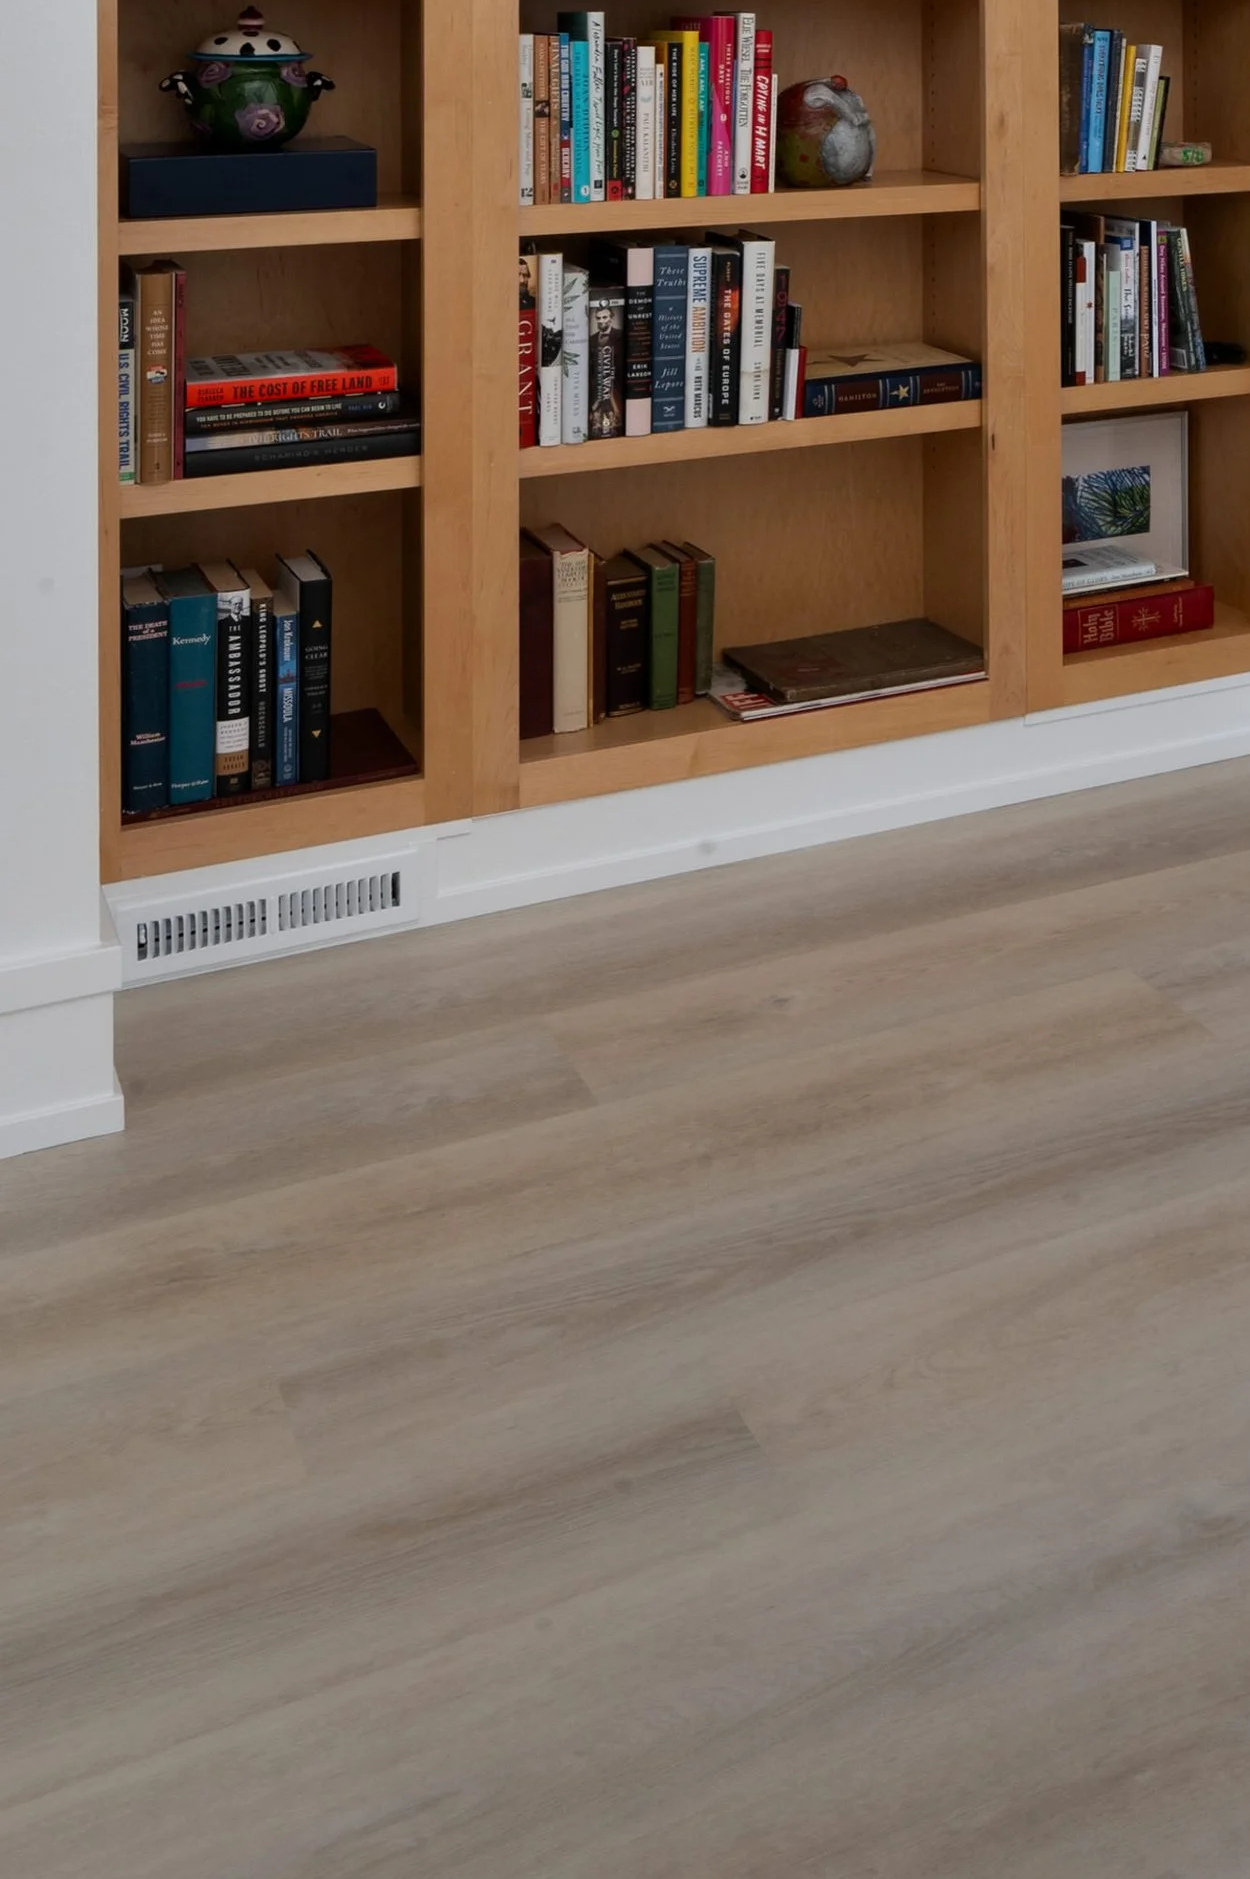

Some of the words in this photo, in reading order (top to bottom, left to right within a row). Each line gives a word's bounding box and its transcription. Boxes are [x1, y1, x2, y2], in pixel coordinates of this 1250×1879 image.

[742, 16, 754, 35] ELIE
[551, 41, 559, 76] FINAL
[740, 36, 752, 64] WIESEL
[740, 68, 752, 83] THE
[551, 78, 559, 110] GIFTS
[738, 84, 752, 128] FORGOTTEN
[757, 75, 769, 112] CRYING
[756, 125, 768, 135] H
[716, 141, 724, 177] PATCHETT
[754, 137, 767, 170] MART
[657, 279, 687, 288] Truths
[659, 267, 685, 276] These
[692, 256, 707, 303] SUPREME
[721, 289, 732, 308] THE
[119, 308, 129, 342] MOON
[692, 306, 707, 353] AMBITION
[721, 312, 732, 344] GATES
[119, 353, 129, 368] U.S.
[519, 320, 532, 416] GRANT
[602, 346, 612, 377] CIVIL
[632, 363, 648, 371] ERIK
[721, 348, 732, 362] OF
[119, 373, 129, 398] CIVIL
[654, 380, 684, 390] Lepore
[661, 367, 679, 379] Jill
[693, 376, 702, 391] RUTH
[721, 365, 732, 405] EUROPE
[233, 385, 254, 400] THE
[259, 384, 289, 398] COST
[292, 381, 307, 394] OF
[310, 379, 338, 393] FREE
[342, 376, 373, 391] LAND
[602, 379, 612, 401] WAR
[838, 393, 877, 402] HAMILTON
[693, 392, 702, 419] MARCUS
[119, 401, 129, 437] RIGHTS
[119, 439, 129, 469] TRAIL
[259, 603, 267, 622] KING
[284, 619, 294, 632] Jon
[128, 631, 168, 641] PRESIDENT
[172, 633, 211, 646] Kennedy
[1083, 612, 1102, 644] Holy
[259, 625, 267, 666] LEOPOLD'S
[228, 635, 242, 715] AMBASSADOR
[259, 669, 267, 693] GHOST
[282, 687, 293, 723] MISSOULA
